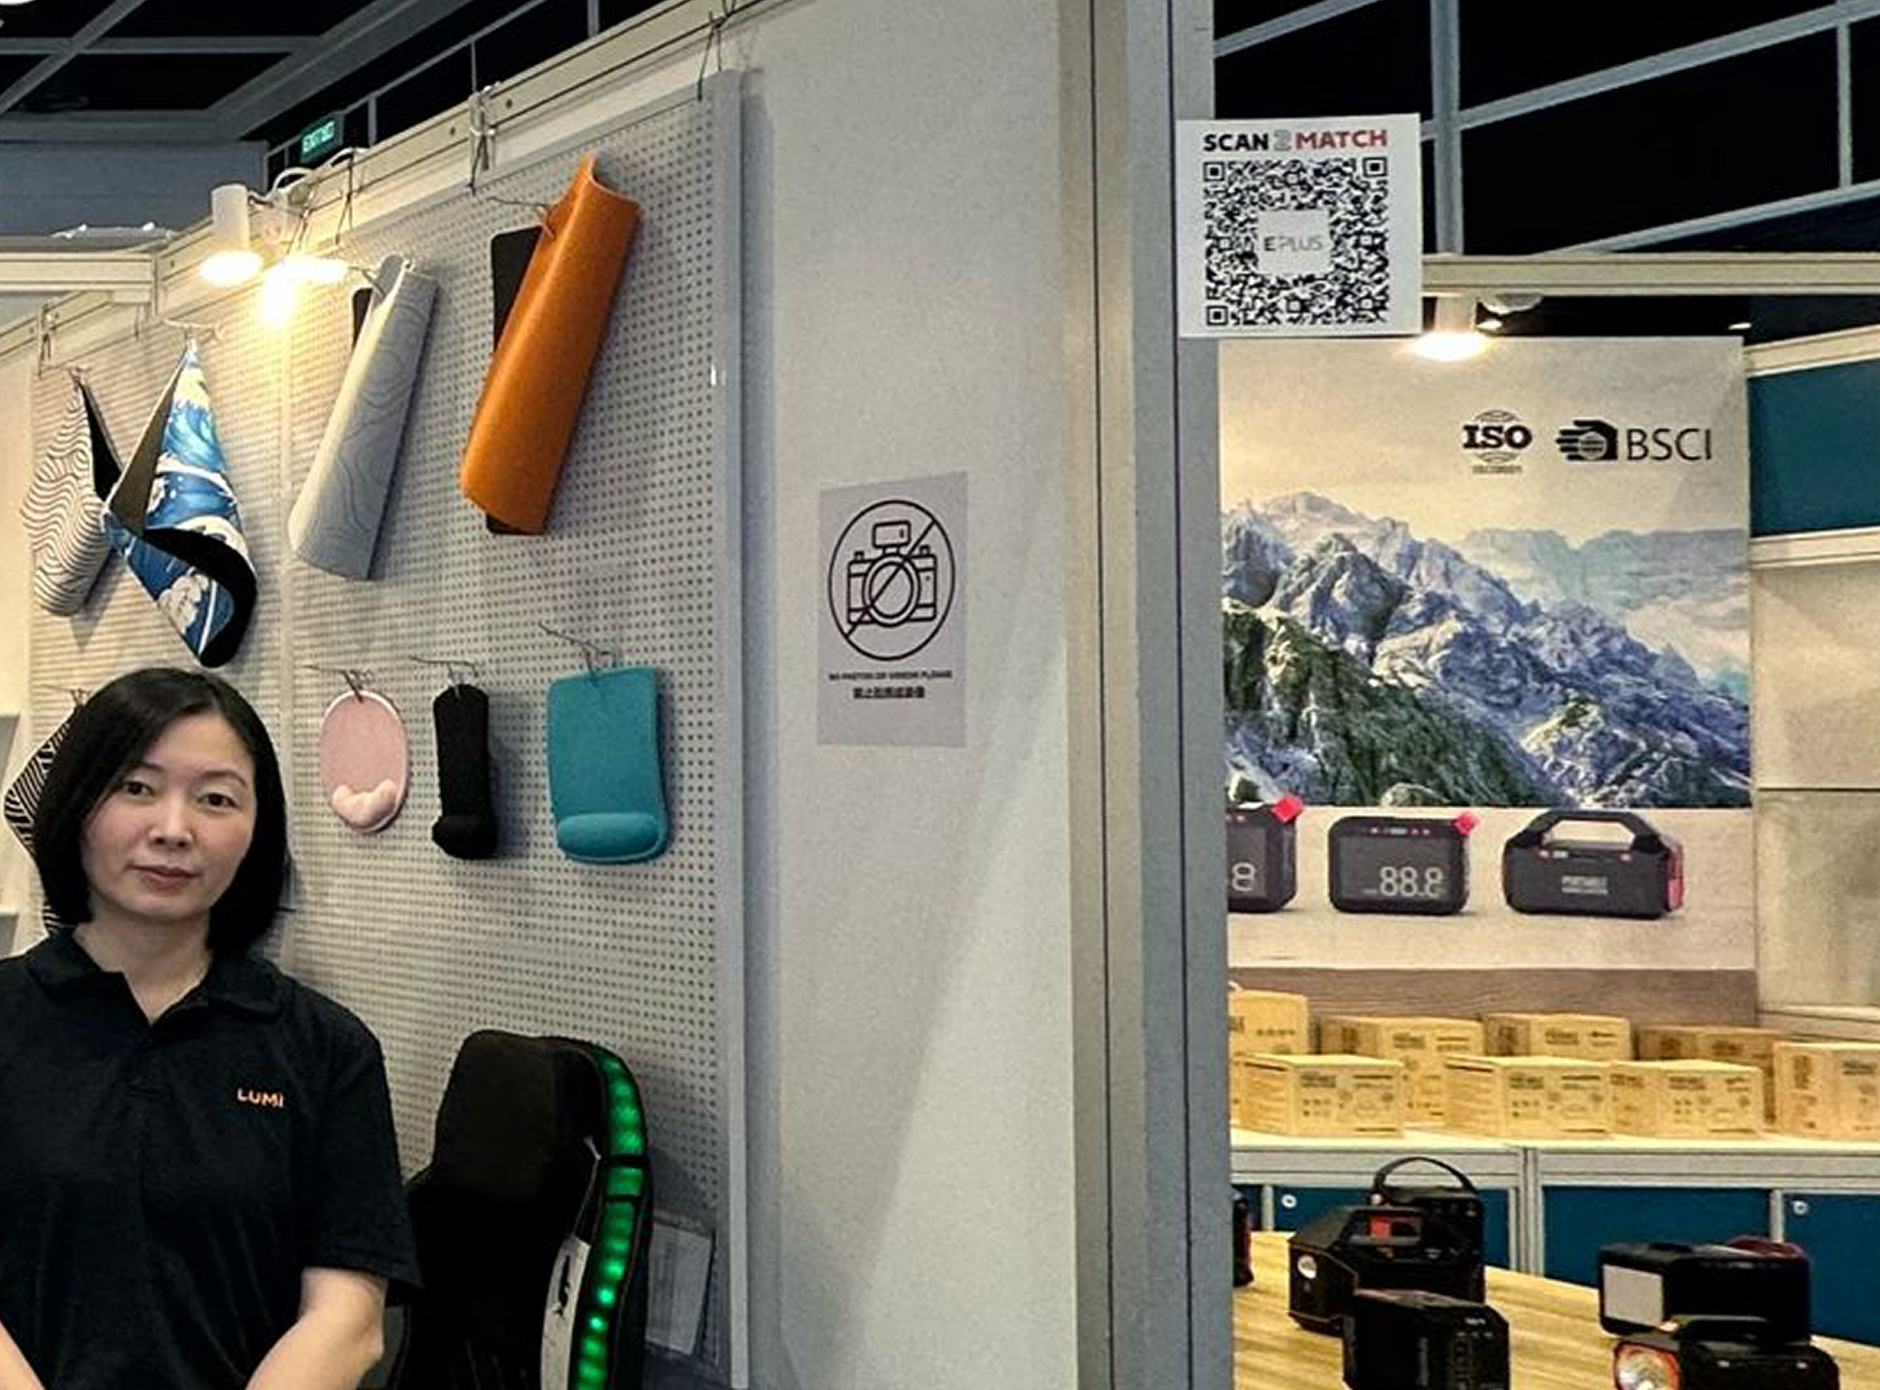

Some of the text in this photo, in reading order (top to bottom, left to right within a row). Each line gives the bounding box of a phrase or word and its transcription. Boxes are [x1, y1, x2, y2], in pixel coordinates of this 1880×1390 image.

[1203, 133, 1269, 151] SCAN
[1296, 129, 1388, 150] MATCH
[1462, 425, 1533, 450] ISO
[1626, 428, 1713, 461] BSCI
